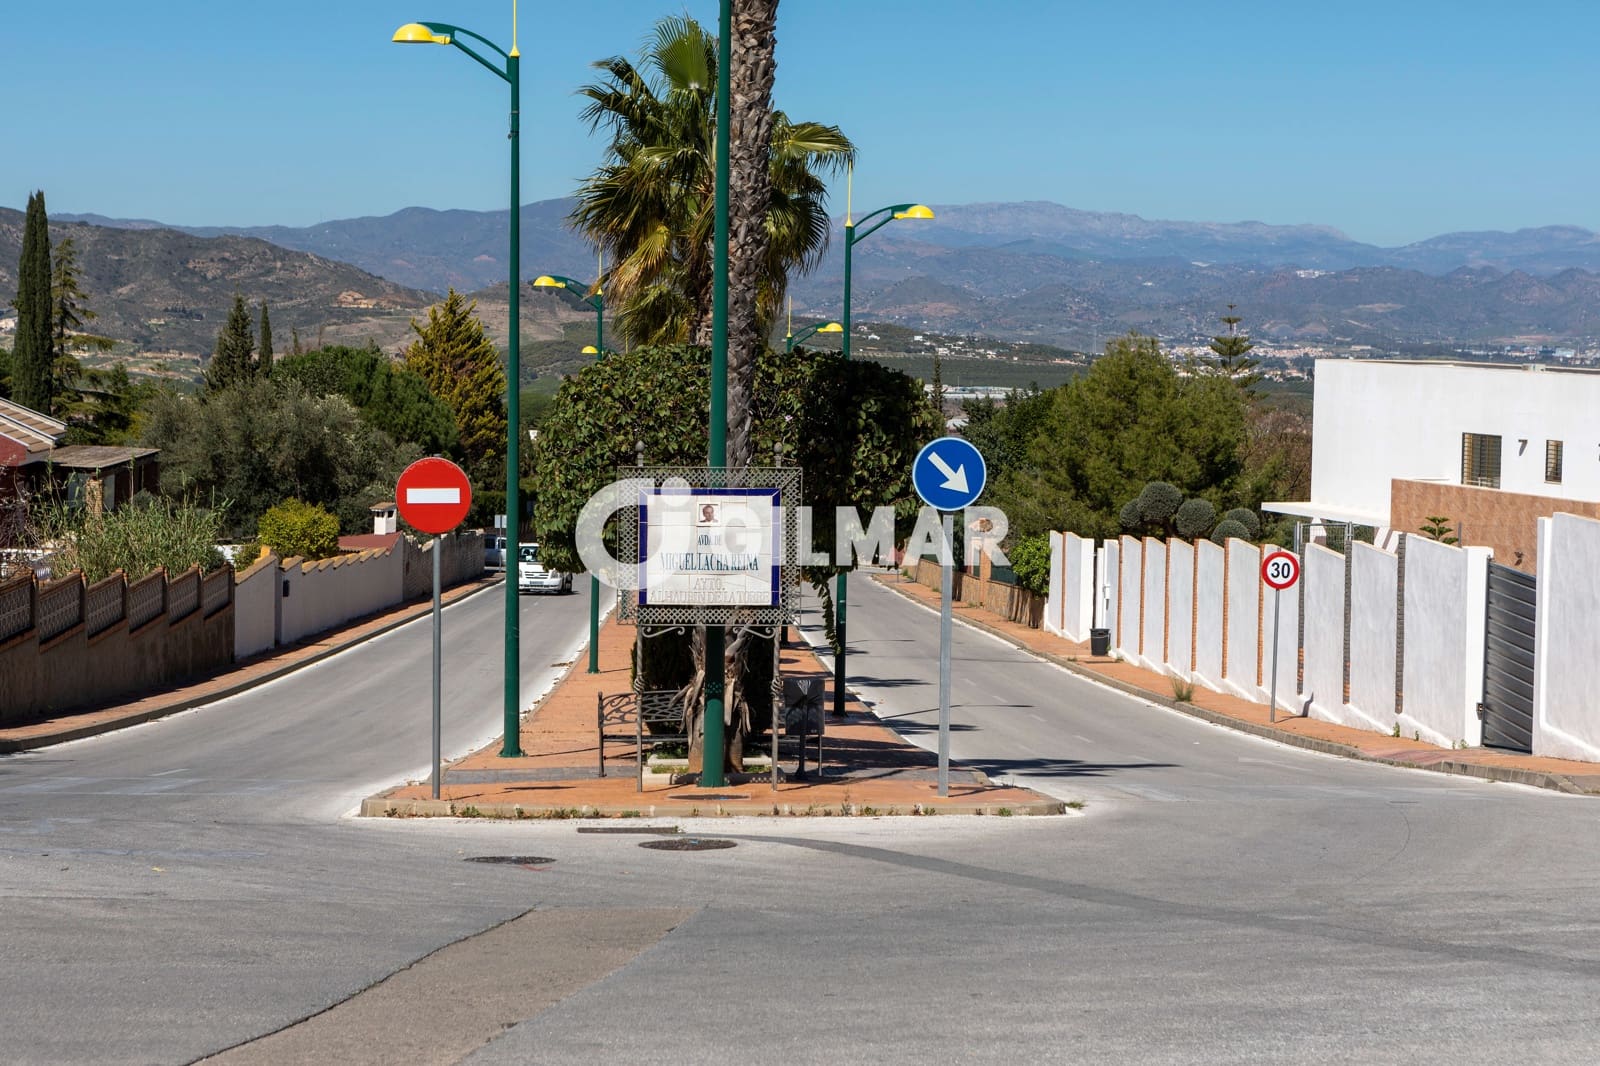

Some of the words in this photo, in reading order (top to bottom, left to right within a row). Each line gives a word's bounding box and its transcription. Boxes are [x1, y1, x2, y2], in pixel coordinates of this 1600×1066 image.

[1518, 439, 1528, 457] 7
[660, 552, 696, 571] MIGUEL
[1271, 562, 1290, 579] 30
